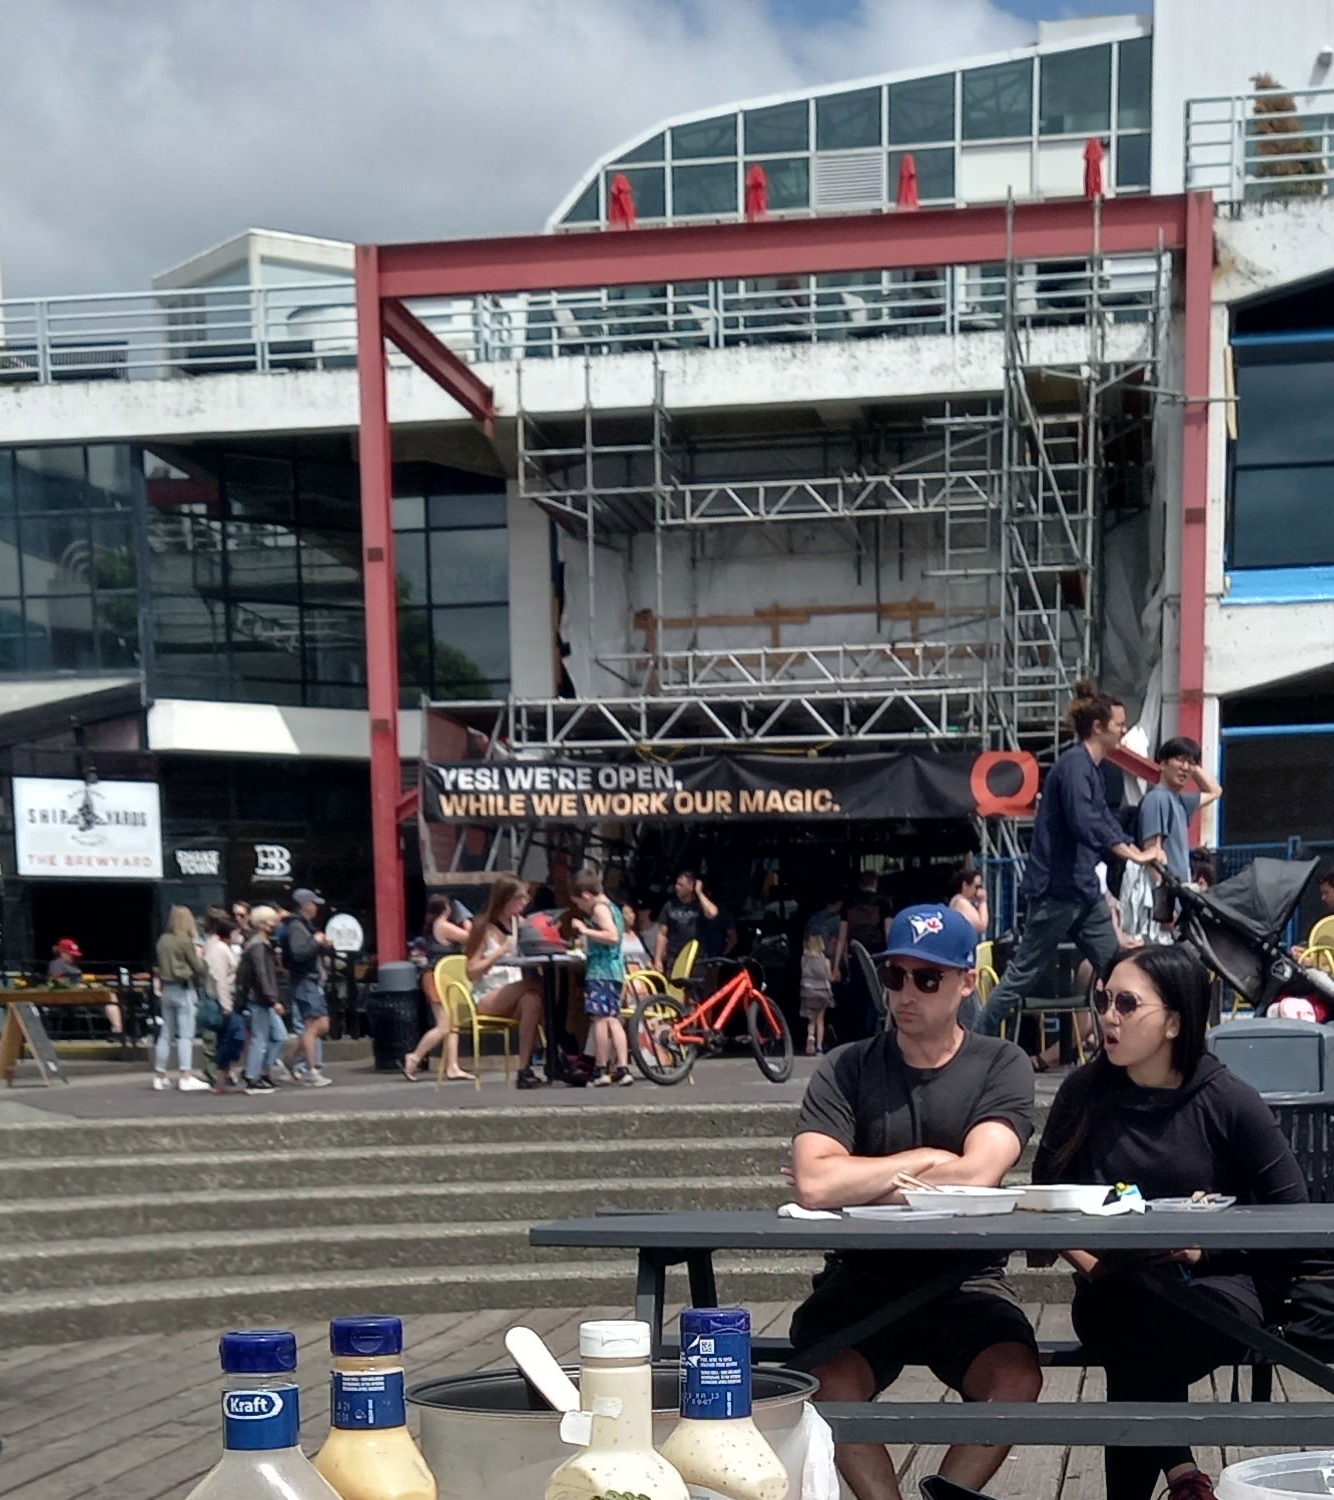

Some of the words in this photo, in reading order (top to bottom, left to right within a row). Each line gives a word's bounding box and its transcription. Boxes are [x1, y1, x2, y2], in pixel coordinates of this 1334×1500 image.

[438, 766, 500, 791] YES!
[505, 766, 593, 790] WE'RE
[598, 765, 684, 791] OPEN,
[439, 793, 527, 817] WHILE
[531, 793, 578, 817] WE
[583, 791, 669, 816] WORK
[673, 791, 732, 815] OUR
[739, 788, 841, 813] MAGIC.
[27, 854, 57, 867] THE
[64, 854, 153, 868] BREWYARD
[229, 1396, 269, 1413] Kraft
